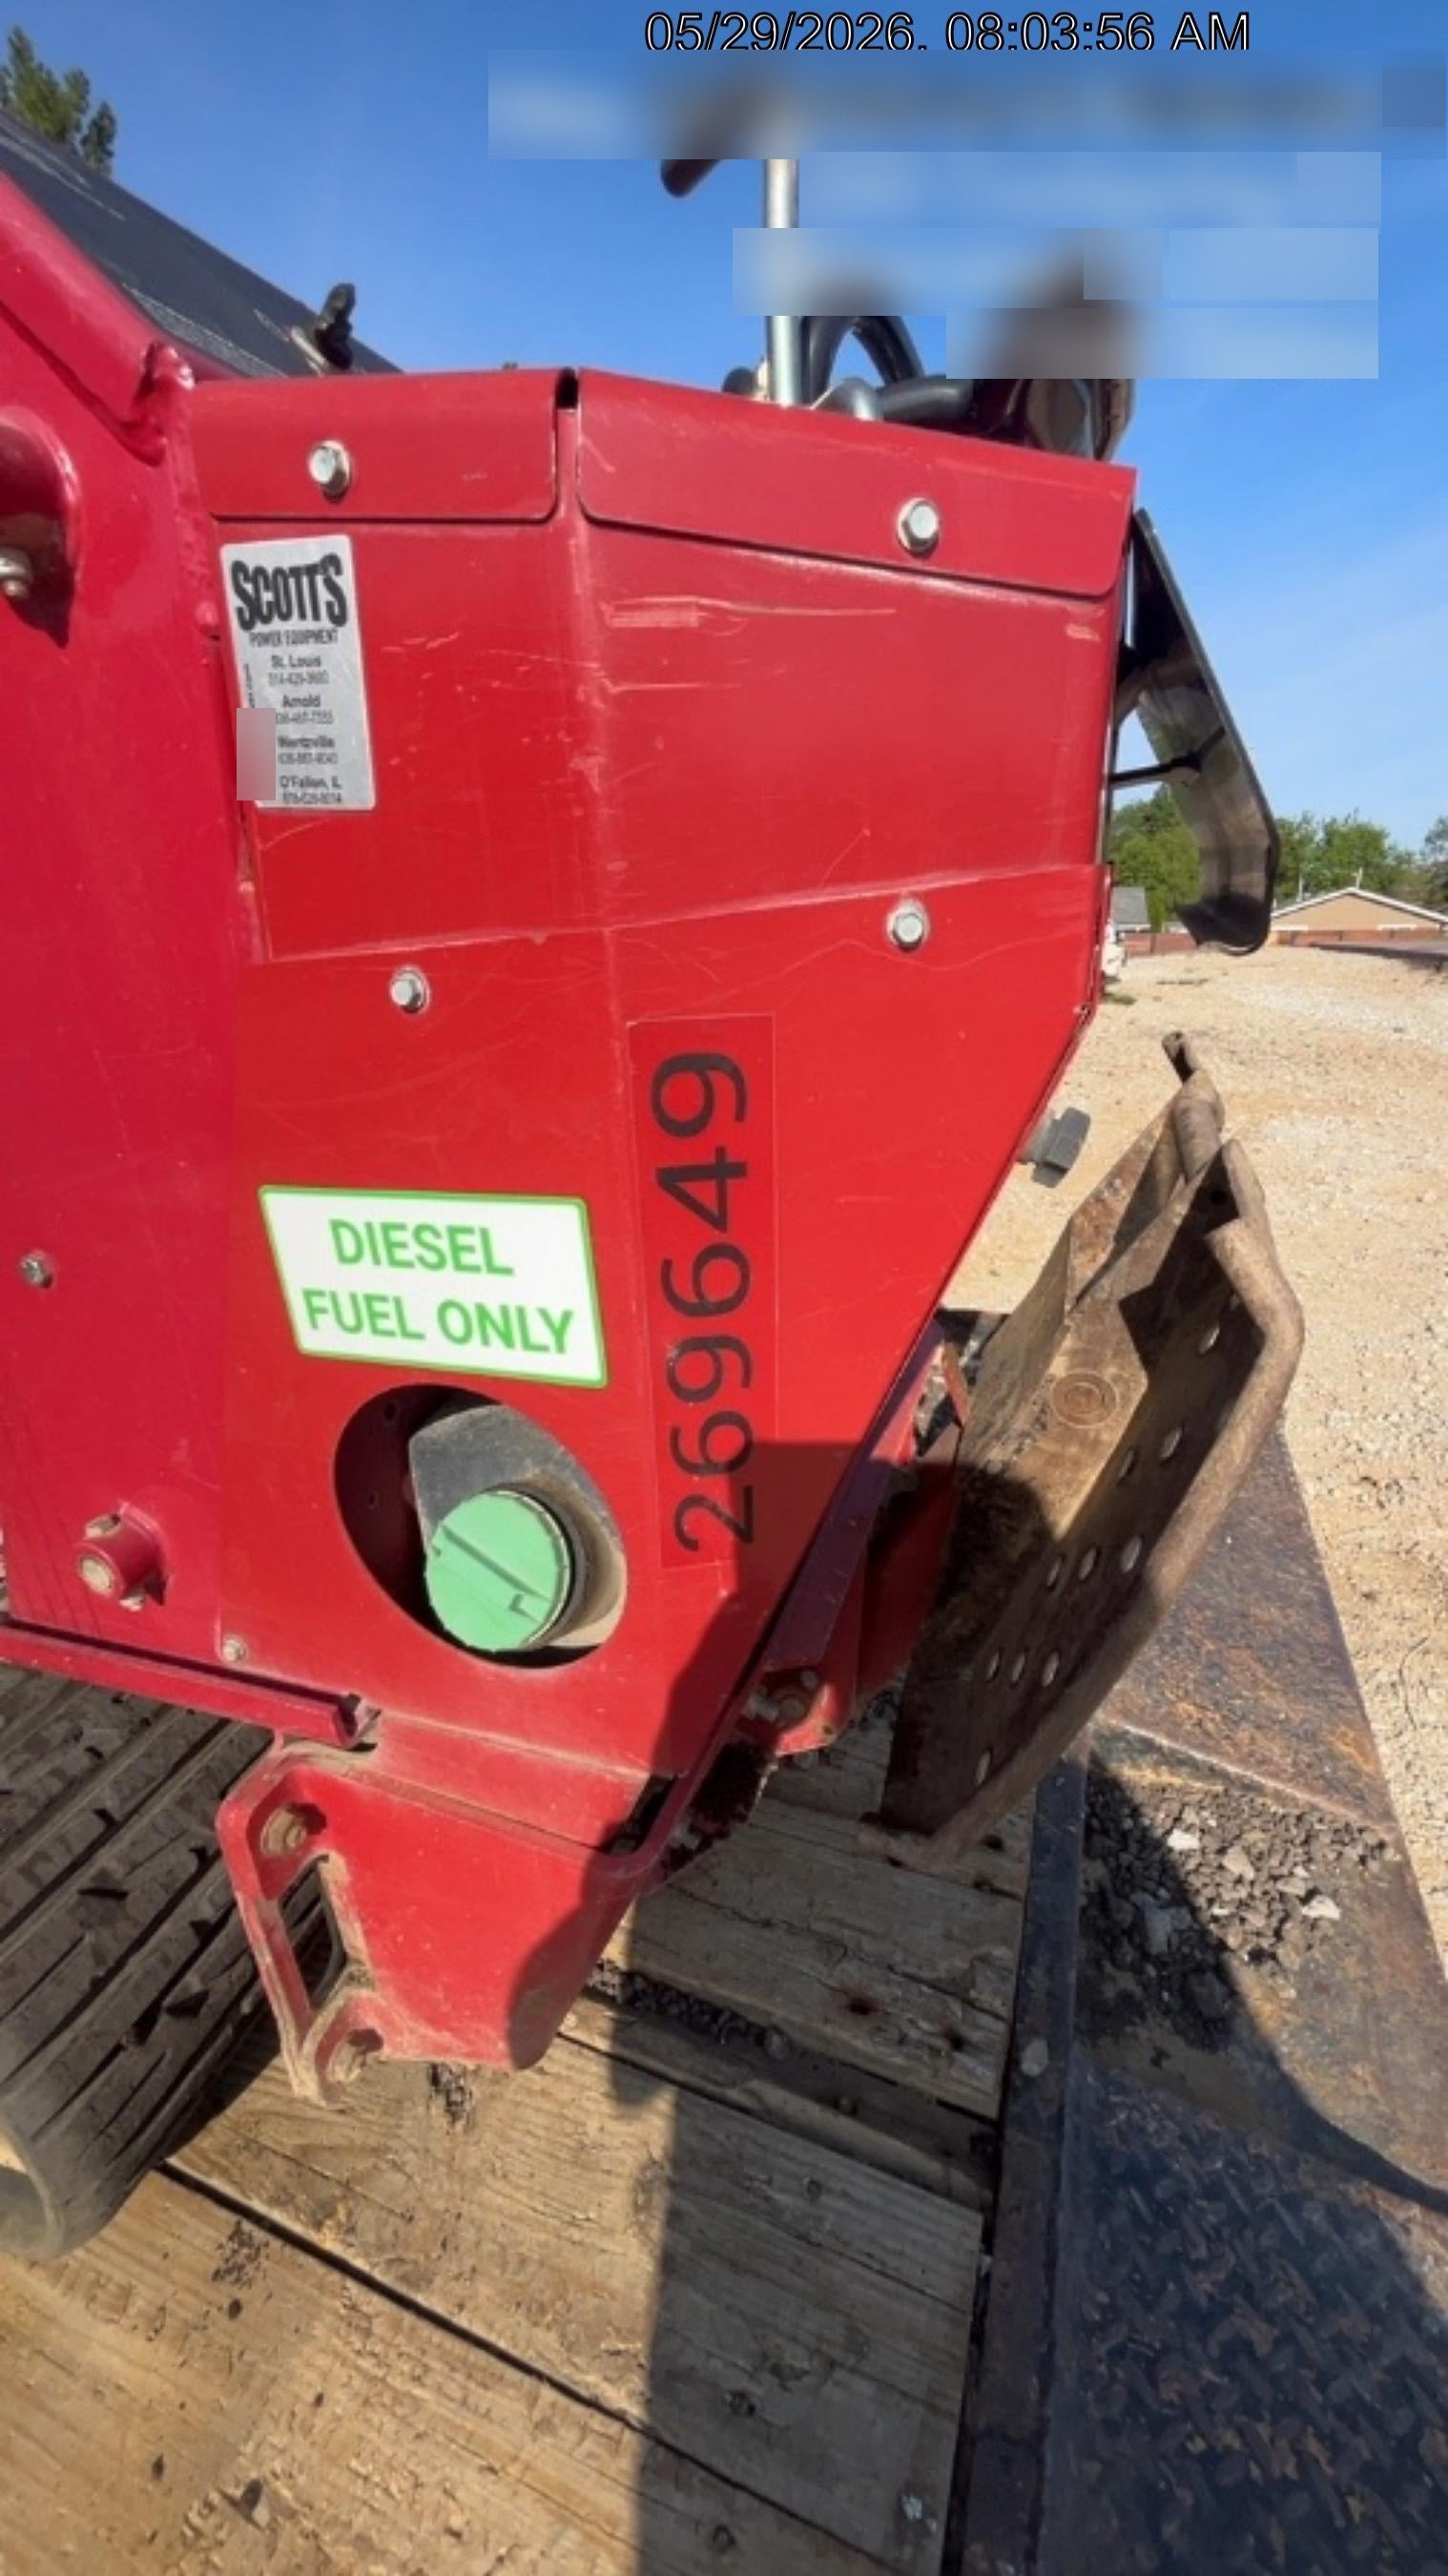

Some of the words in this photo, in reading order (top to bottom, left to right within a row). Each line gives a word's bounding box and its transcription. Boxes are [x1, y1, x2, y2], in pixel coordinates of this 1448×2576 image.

[249, 632, 281, 648] POWER
[285, 628, 339, 646] EQUIPMENT
[289, 654, 321, 668] Louis
[282, 695, 321, 708] Arnold
[329, 1218, 514, 1277] DIESEL
[302, 1288, 426, 1340] FUEL
[437, 1298, 573, 1355] ONLY
[650, 1052, 754, 1552] 269649
